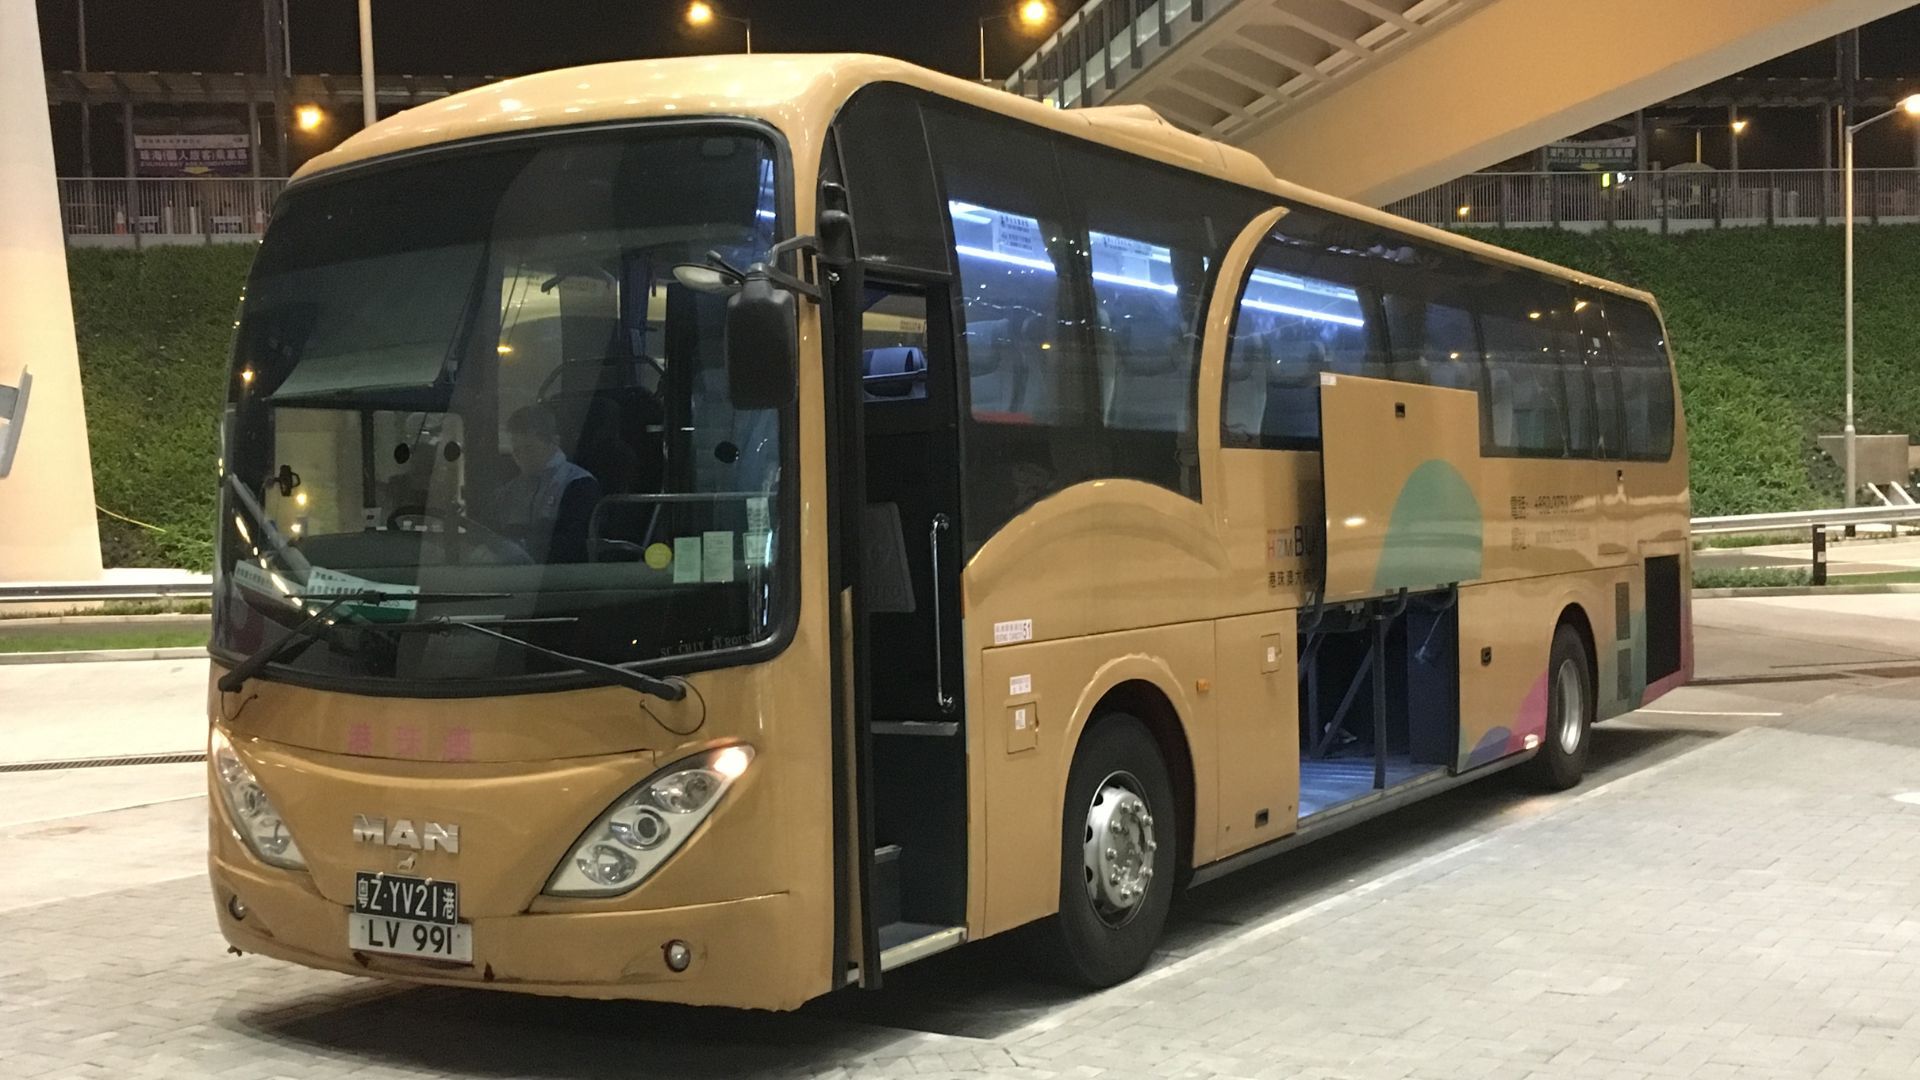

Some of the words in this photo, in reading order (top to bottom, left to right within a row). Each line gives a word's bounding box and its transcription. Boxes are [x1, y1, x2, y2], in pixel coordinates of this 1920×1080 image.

[353, 813, 459, 854] MAN
[369, 919, 400, 948] LV
[412, 925, 452, 954] 991
